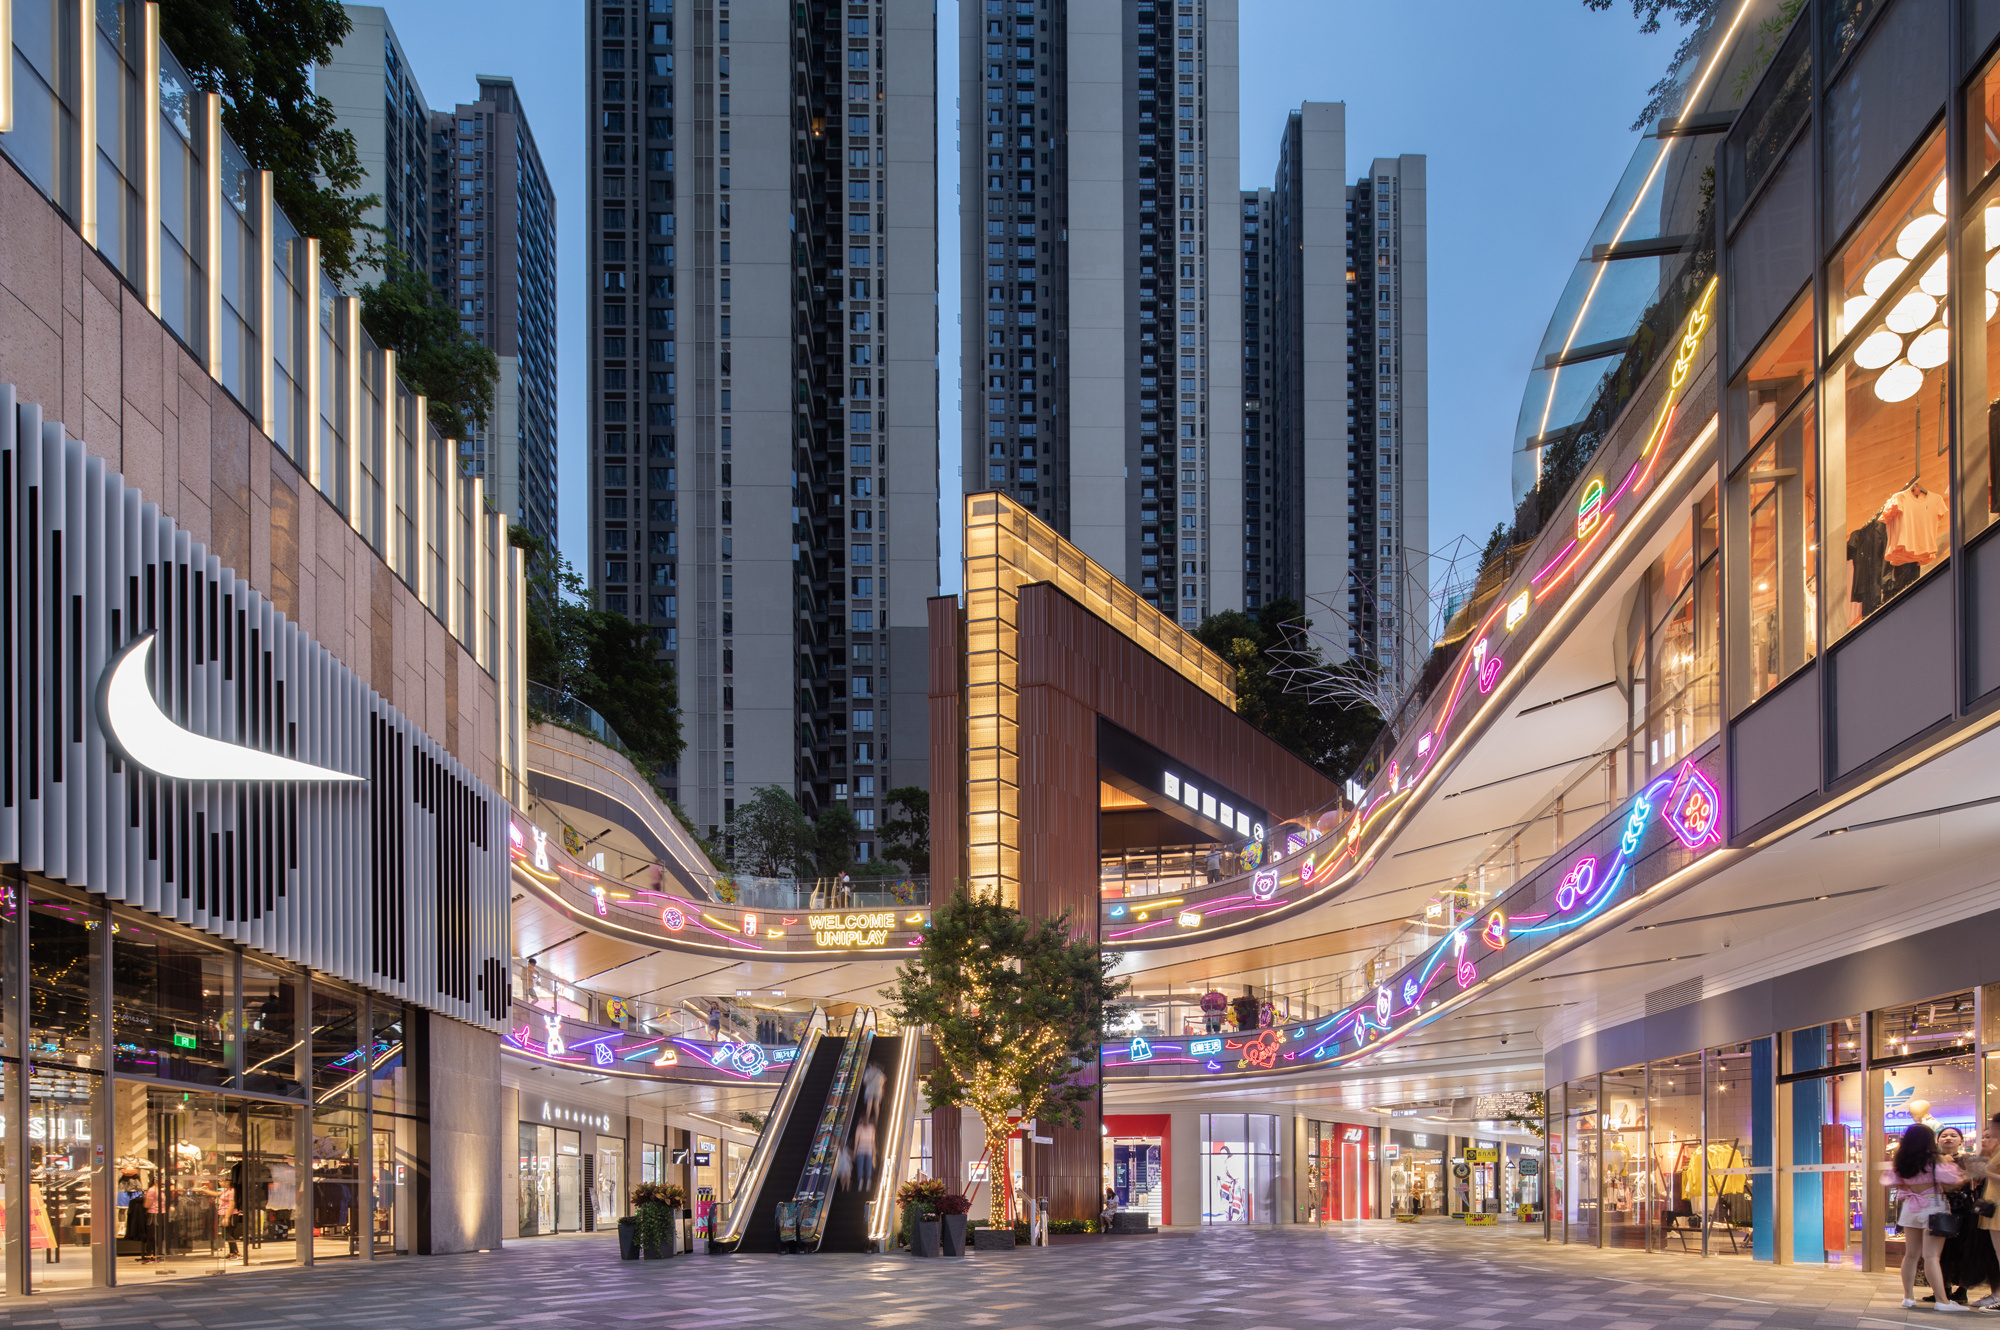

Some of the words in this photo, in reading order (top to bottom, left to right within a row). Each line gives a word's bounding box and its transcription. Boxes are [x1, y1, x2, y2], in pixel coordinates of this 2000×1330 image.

[809, 913, 895, 930] WELCOME
[816, 930, 888, 946] UNIPLAY
[1344, 1127, 1363, 1141] FILA
